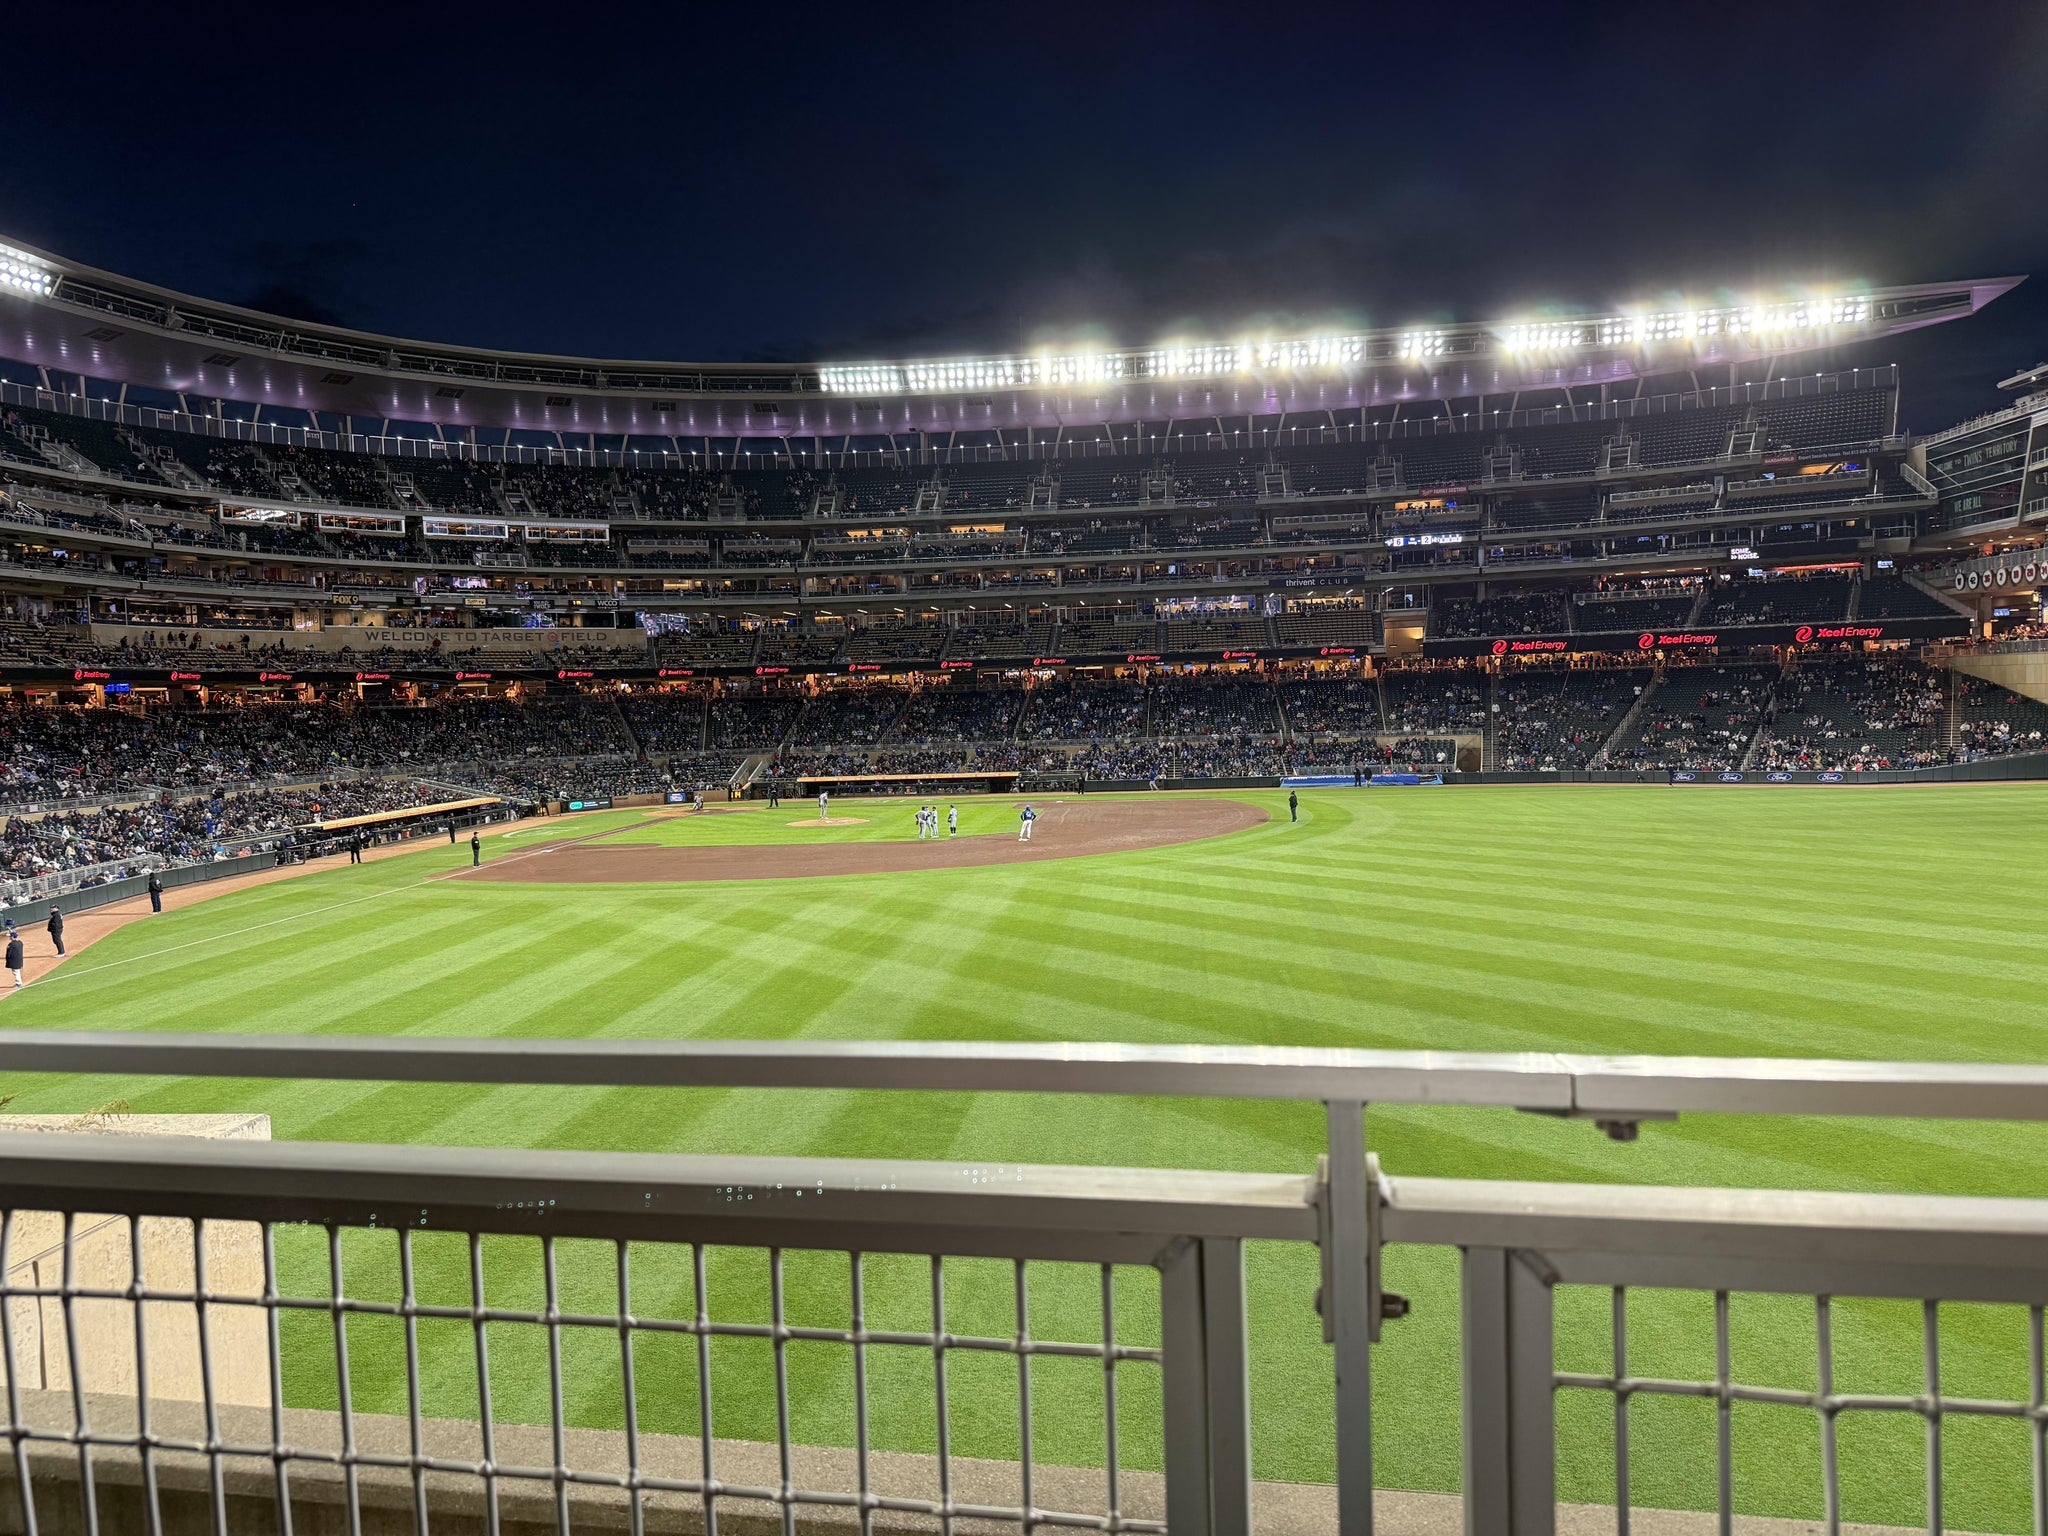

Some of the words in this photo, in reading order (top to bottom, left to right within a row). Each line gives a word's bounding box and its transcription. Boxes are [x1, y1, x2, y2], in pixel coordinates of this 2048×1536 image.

[1963, 450, 1982, 466] TWINS
[1985, 440, 2017, 459] TERRITORY
[1954, 500, 1962, 513] WE
[1963, 497, 1972, 509] ARE
[1973, 496, 1981, 508] ALL
[1285, 579, 1315, 587] thrivent
[333, 595, 352, 605] FOX
[352, 595, 359, 605] 9
[365, 631, 450, 641] WELCOME
[455, 632, 476, 641] TO
[481, 632, 544, 641] TARGET
[561, 632, 607, 641] FIELD
[1818, 628, 1845, 637] Xcel
[1845, 627, 1882, 638] Energy
[1658, 635, 1683, 644] Xcel
[1683, 634, 1717, 644] Energy
[1511, 642, 1534, 650] Xcel
[1534, 641, 1567, 650] Energy
